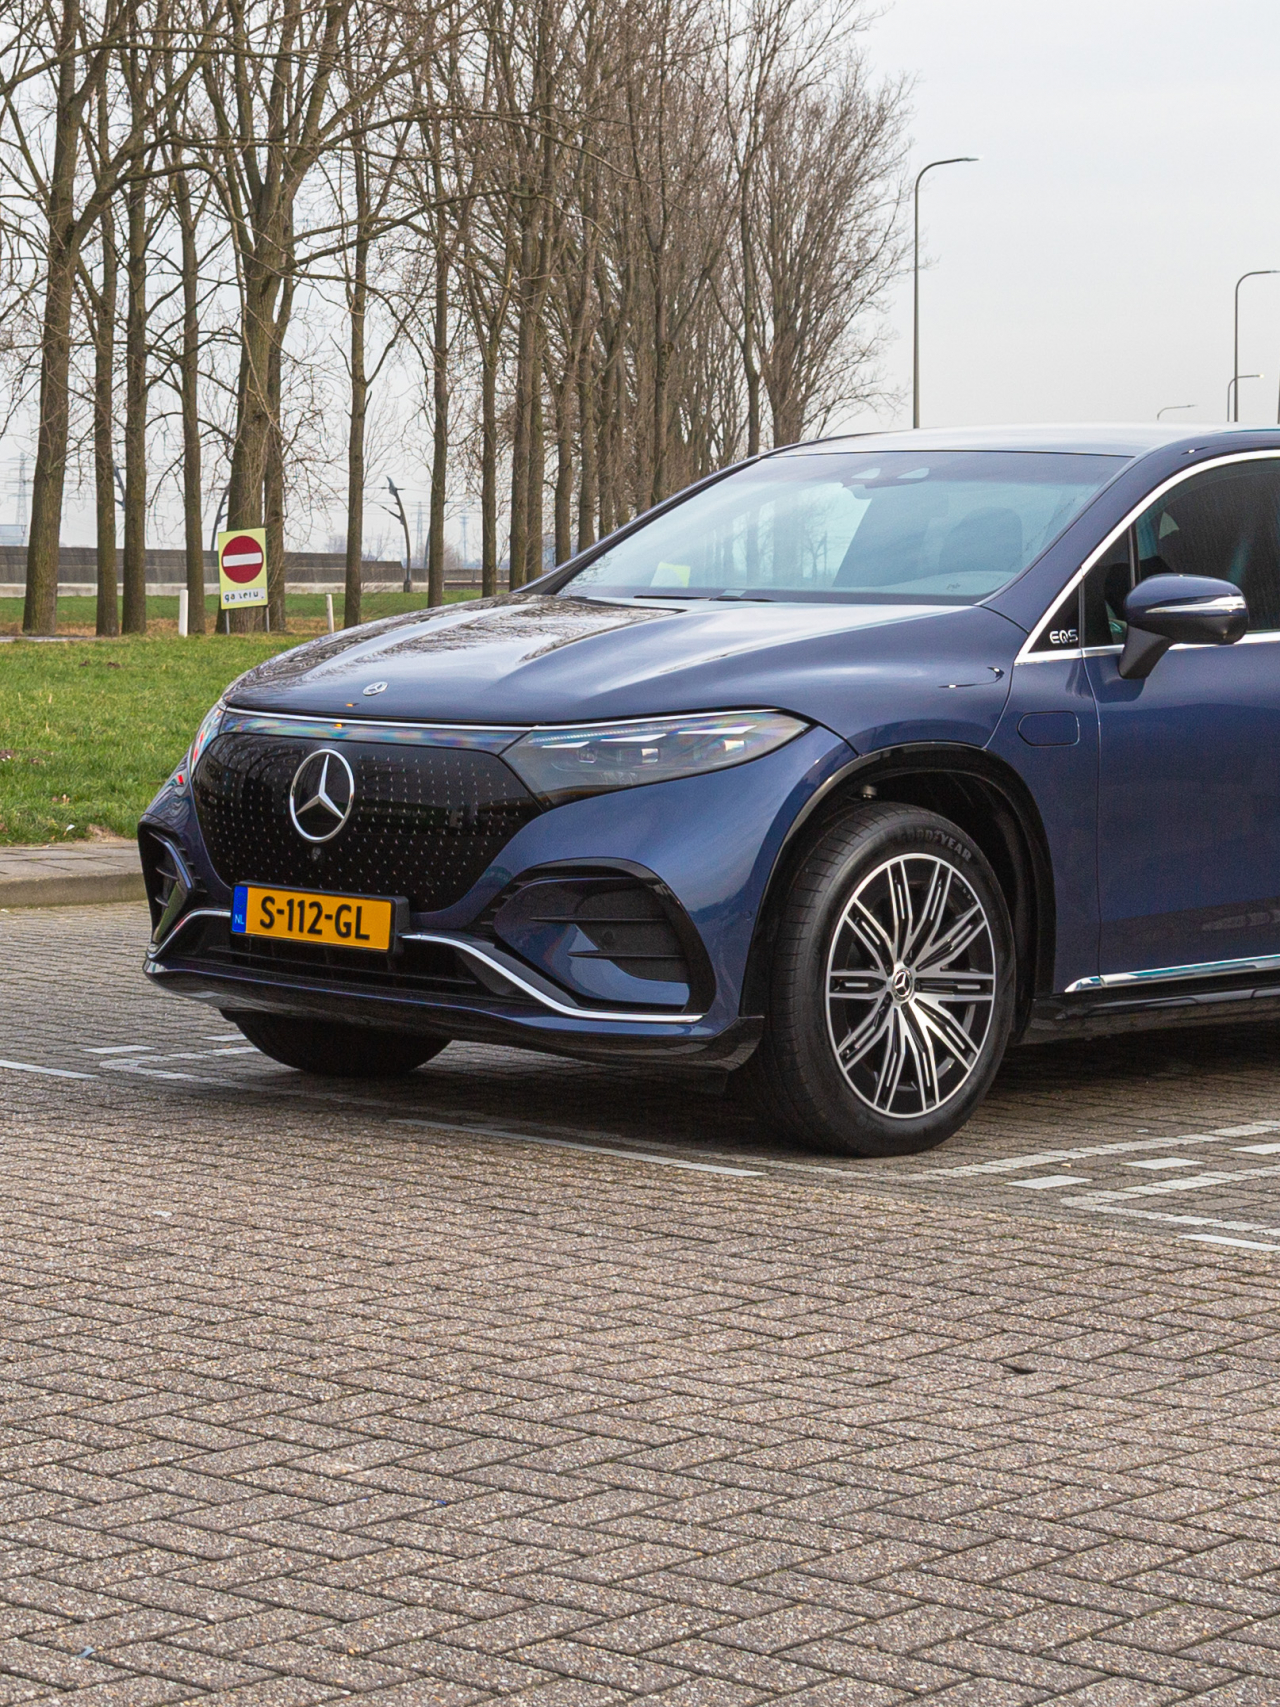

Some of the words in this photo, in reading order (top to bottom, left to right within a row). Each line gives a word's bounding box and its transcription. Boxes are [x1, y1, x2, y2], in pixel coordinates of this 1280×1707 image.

[1049, 628, 1079, 645] EQS
[234, 914, 245, 925] NL
[259, 896, 370, 940] S-112-GL
